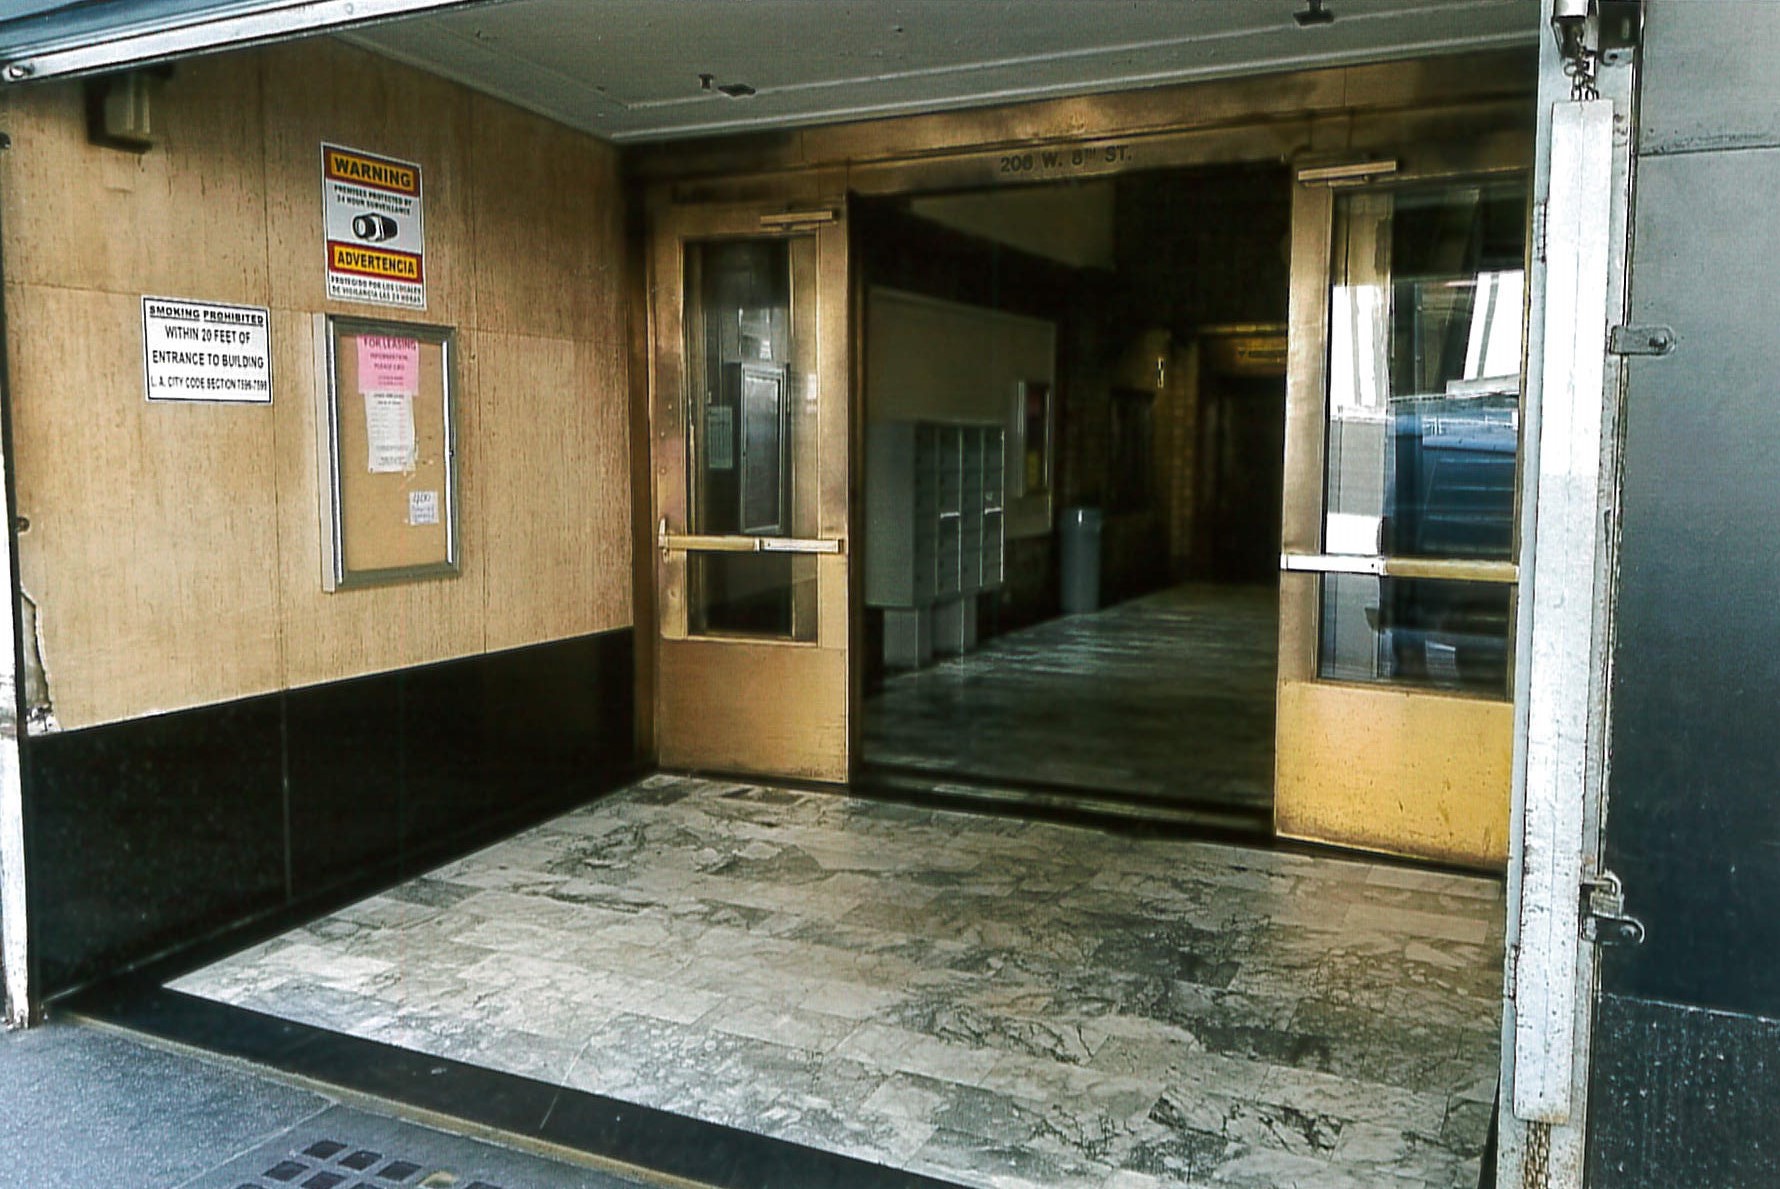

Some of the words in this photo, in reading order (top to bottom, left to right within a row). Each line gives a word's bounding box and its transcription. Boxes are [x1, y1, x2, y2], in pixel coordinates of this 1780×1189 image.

[1042, 151, 1062, 168] W.
[1105, 145, 1132, 162] ST.
[334, 158, 411, 187] WARNING
[346, 196, 365, 206] HOUR
[368, 191, 403, 204] PROTECTED
[404, 198, 412, 206] BY
[338, 251, 415, 275] ADVERTENCIA
[332, 285, 340, 293] DE
[342, 286, 378, 298] VIGILANCIA
[379, 291, 391, 300] LAS
[368, 280, 381, 289] POR
[383, 282, 394, 291] LOS
[149, 305, 200, 319] SMOKING
[203, 310, 264, 325] PROHIBITED
[164, 325, 199, 341] WITHIN
[201, 328, 212, 342] 20
[214, 329, 236, 343] FEET
[238, 331, 251, 344] OF
[152, 350, 205, 366] ENTRANCE
[207, 353, 220, 366] TO
[222, 354, 264, 369] BUILDING
[168, 376, 184, 388] CITY
[185, 376, 205, 389] CODE
[207, 378, 236, 390] SECTION
